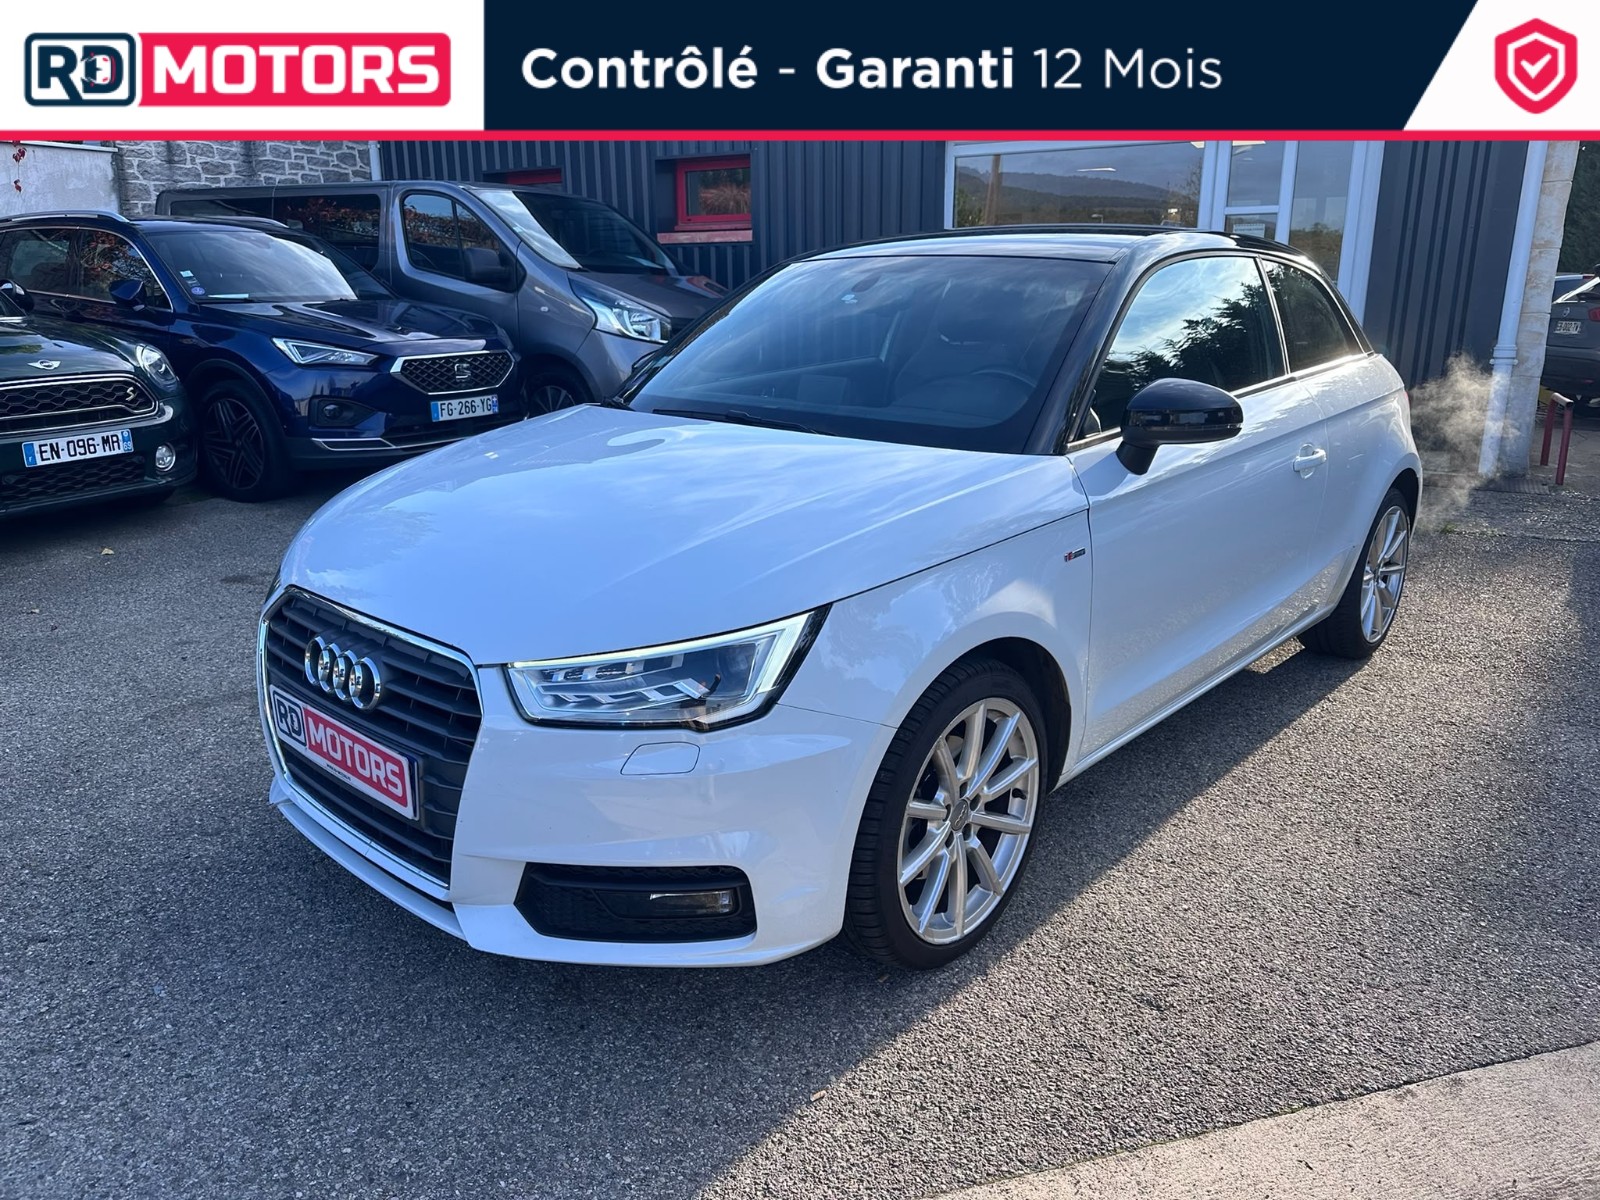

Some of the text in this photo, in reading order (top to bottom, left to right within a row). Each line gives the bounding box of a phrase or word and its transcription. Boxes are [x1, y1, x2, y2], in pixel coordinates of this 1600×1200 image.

[440, 398, 492, 417] FG-266-YG
[38, 434, 121, 462] EN-096-MR
[307, 716, 404, 797] MOTORS
